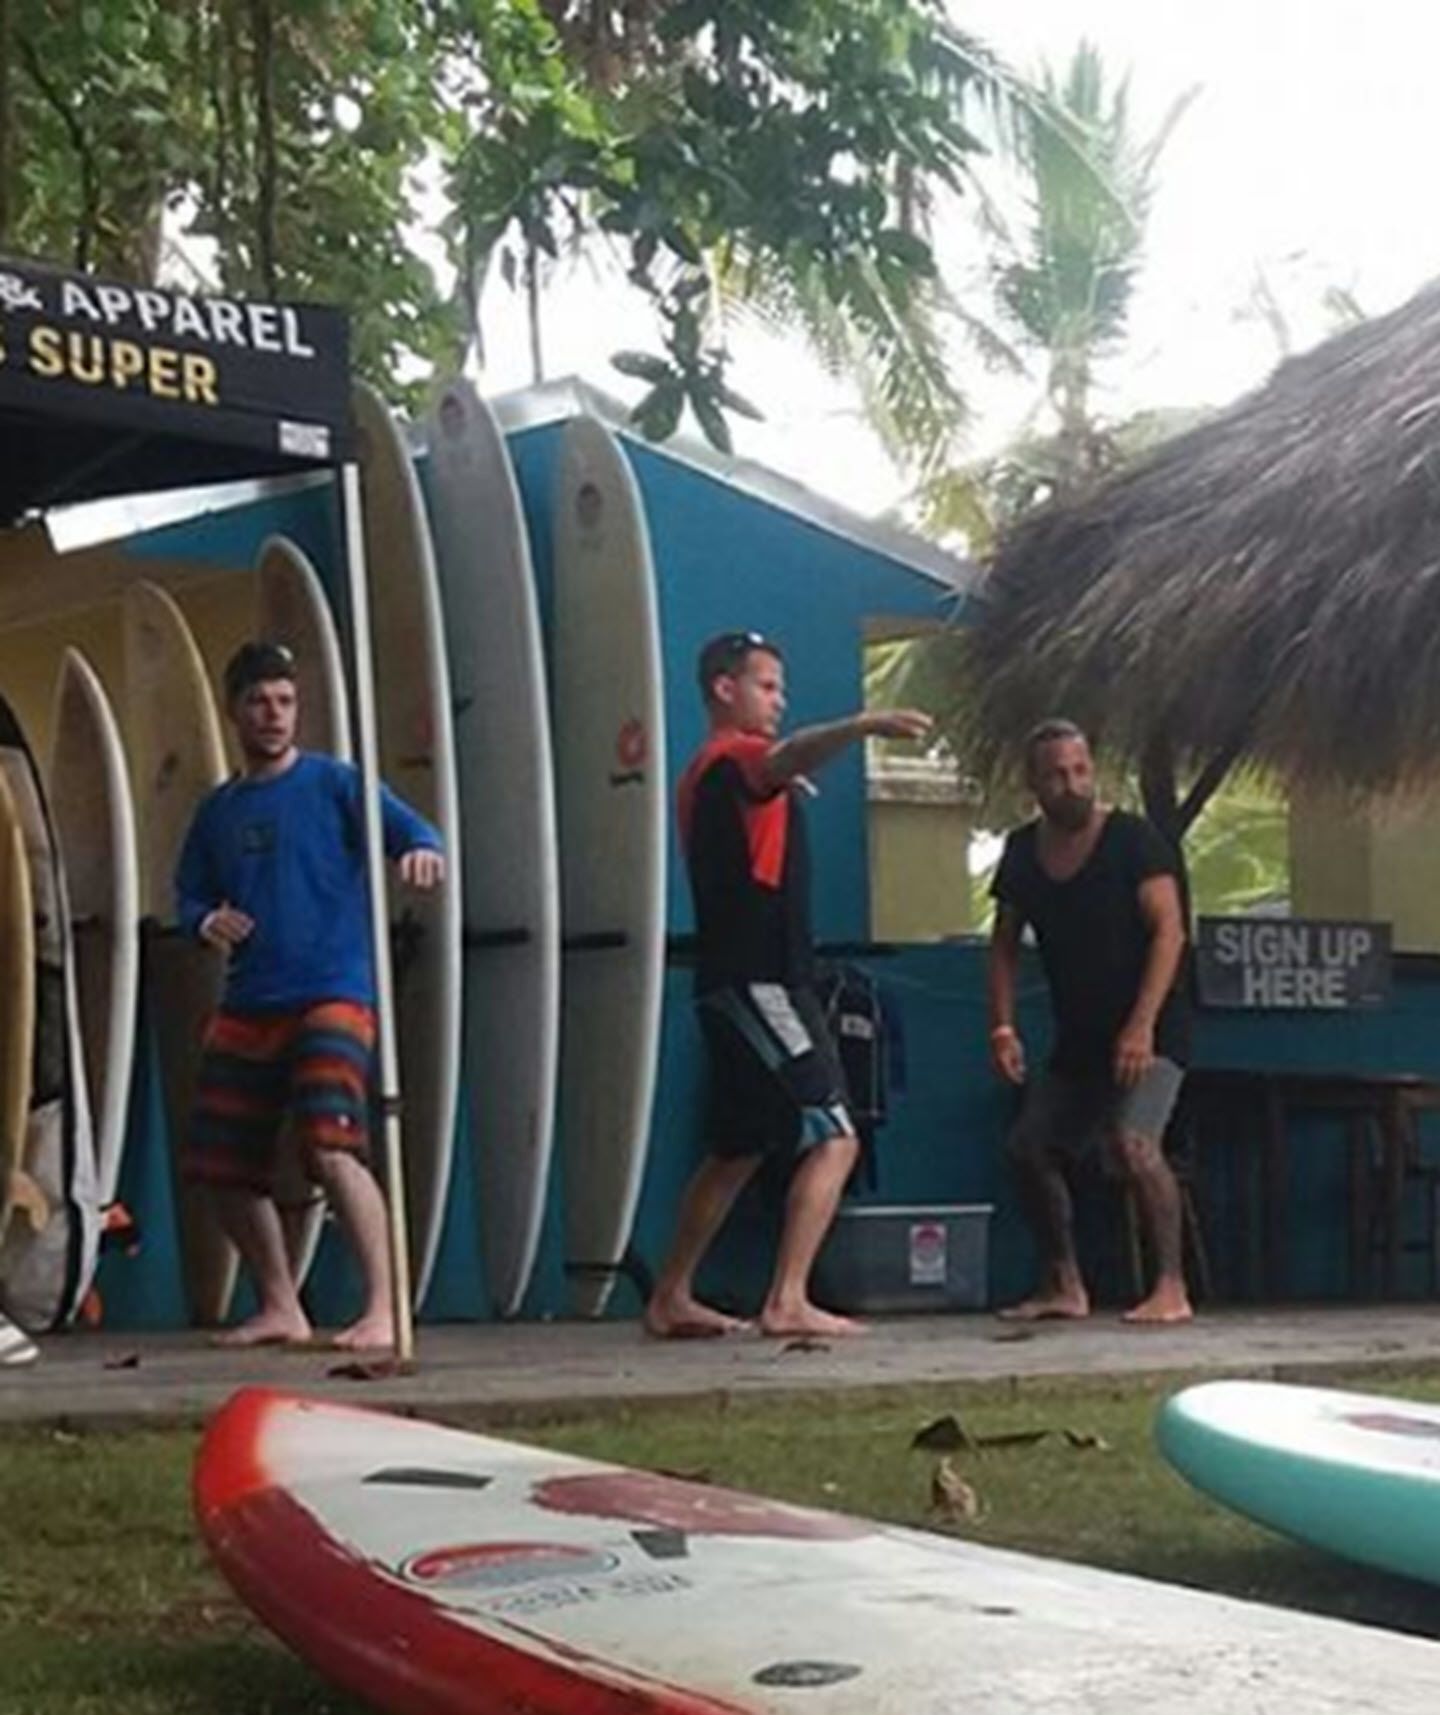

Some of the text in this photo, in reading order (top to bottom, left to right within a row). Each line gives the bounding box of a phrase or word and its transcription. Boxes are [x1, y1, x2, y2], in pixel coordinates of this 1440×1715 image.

[61, 280, 314, 357] APPAREL
[28, 325, 219, 404] SUPER
[1214, 925, 1372, 966] SIGN UP
[1244, 968, 1347, 1006] HERE
